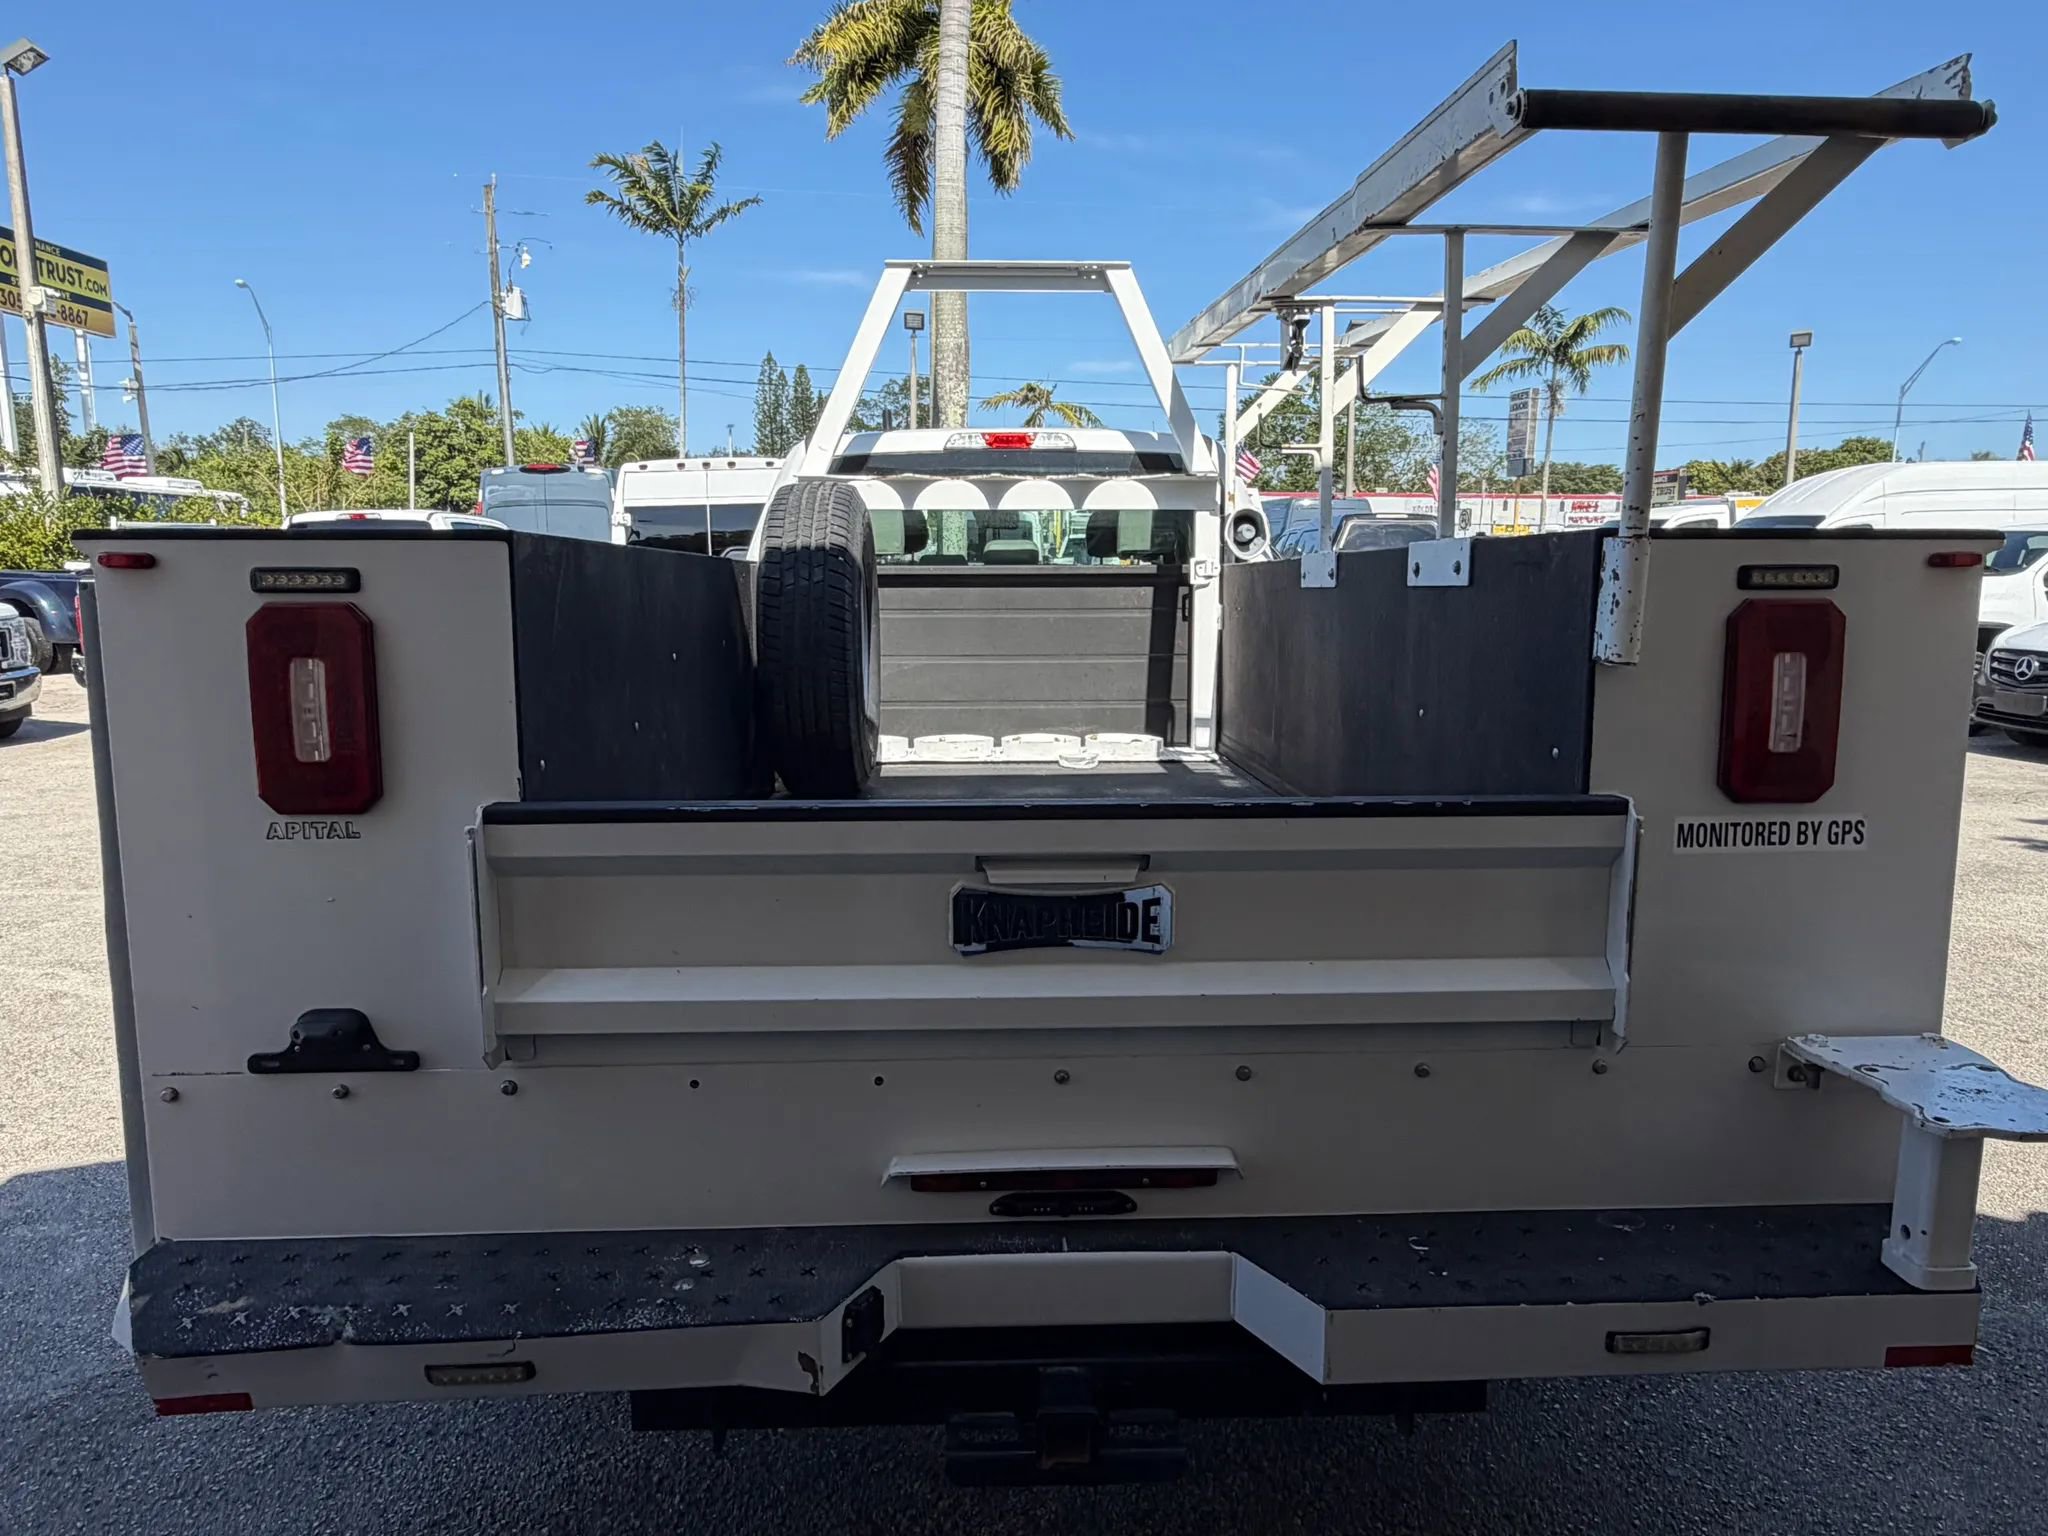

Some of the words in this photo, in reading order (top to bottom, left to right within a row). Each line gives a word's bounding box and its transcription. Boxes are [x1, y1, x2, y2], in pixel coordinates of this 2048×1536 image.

[266, 821, 361, 840] APITAL
[1676, 821, 1791, 849] MONITORED
[1796, 820, 1823, 846] BY
[1828, 819, 1865, 846] GPS
